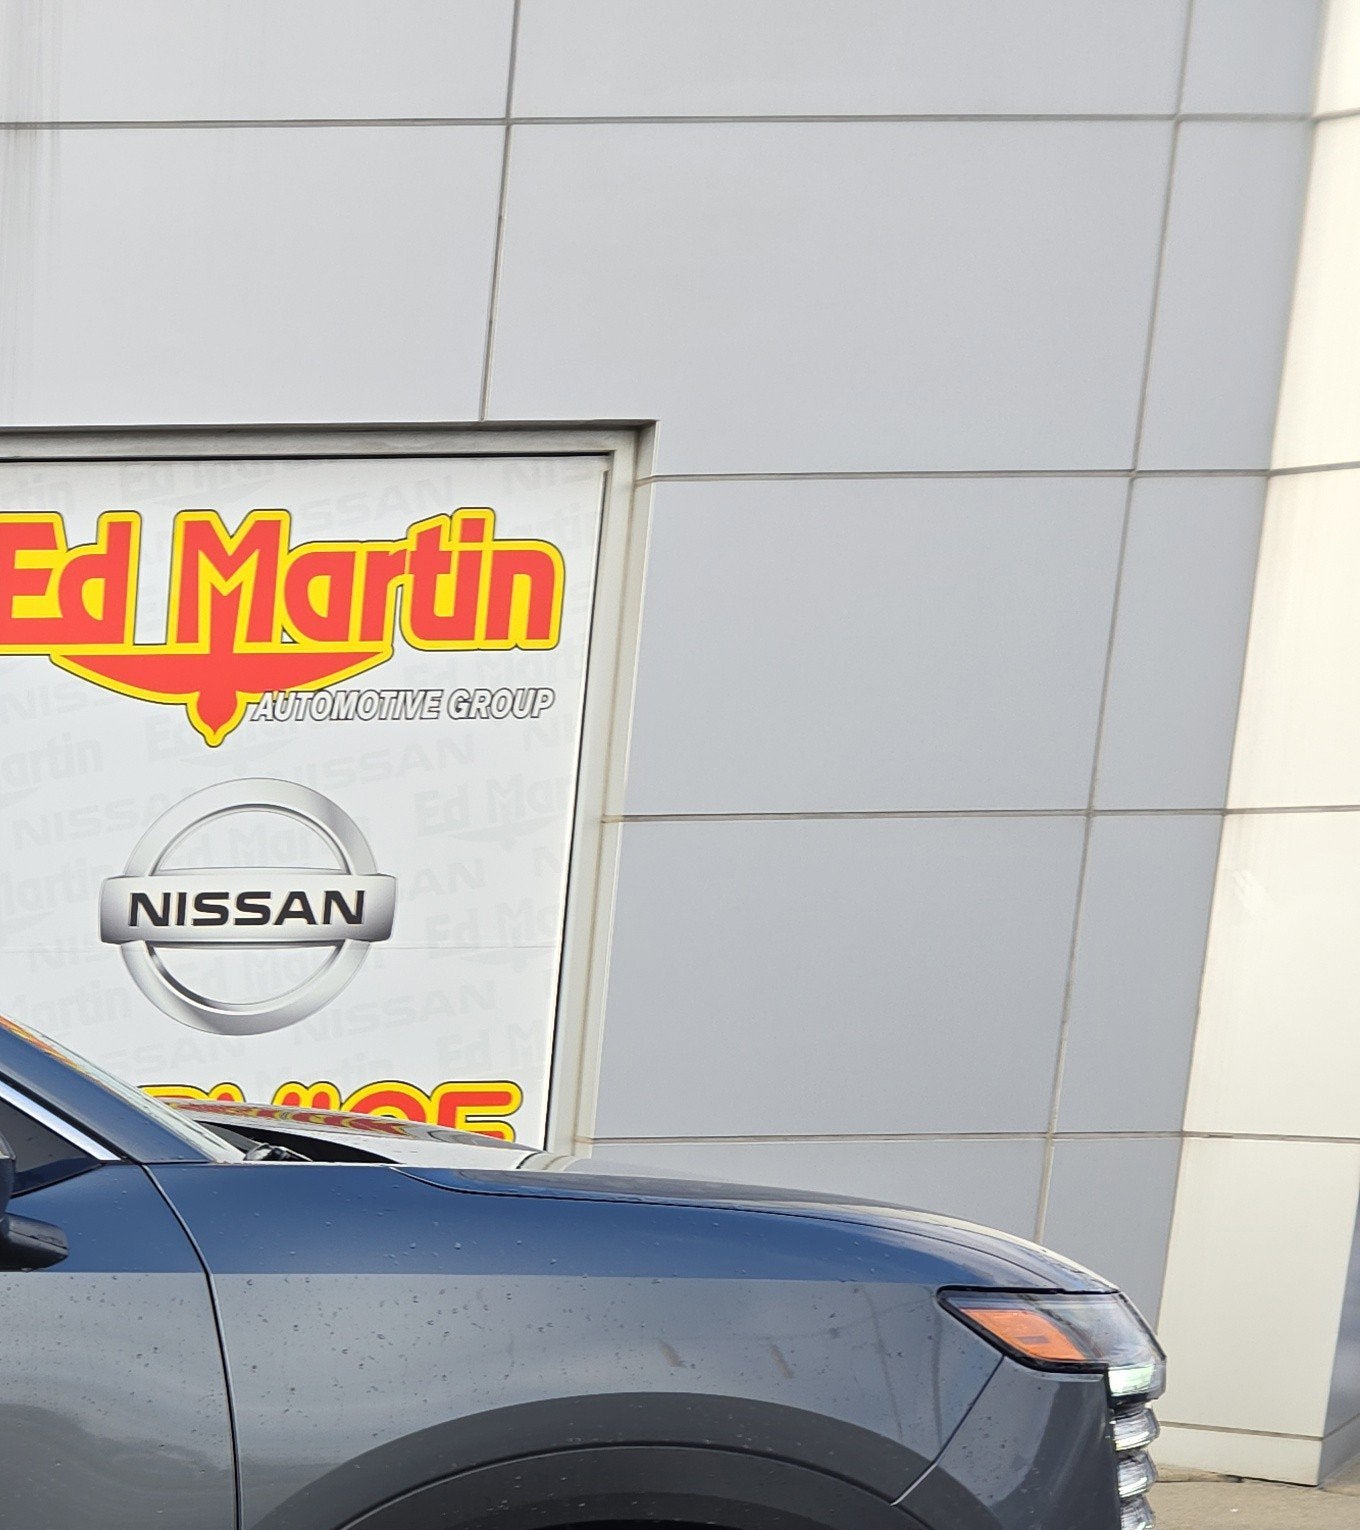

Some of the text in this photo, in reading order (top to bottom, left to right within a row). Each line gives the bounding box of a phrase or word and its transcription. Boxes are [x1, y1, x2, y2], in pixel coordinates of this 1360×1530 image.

[170, 508, 565, 656] Martin
[250, 687, 556, 722] AUTOMOTIVE GROUP
[128, 888, 366, 929] NISSAN
